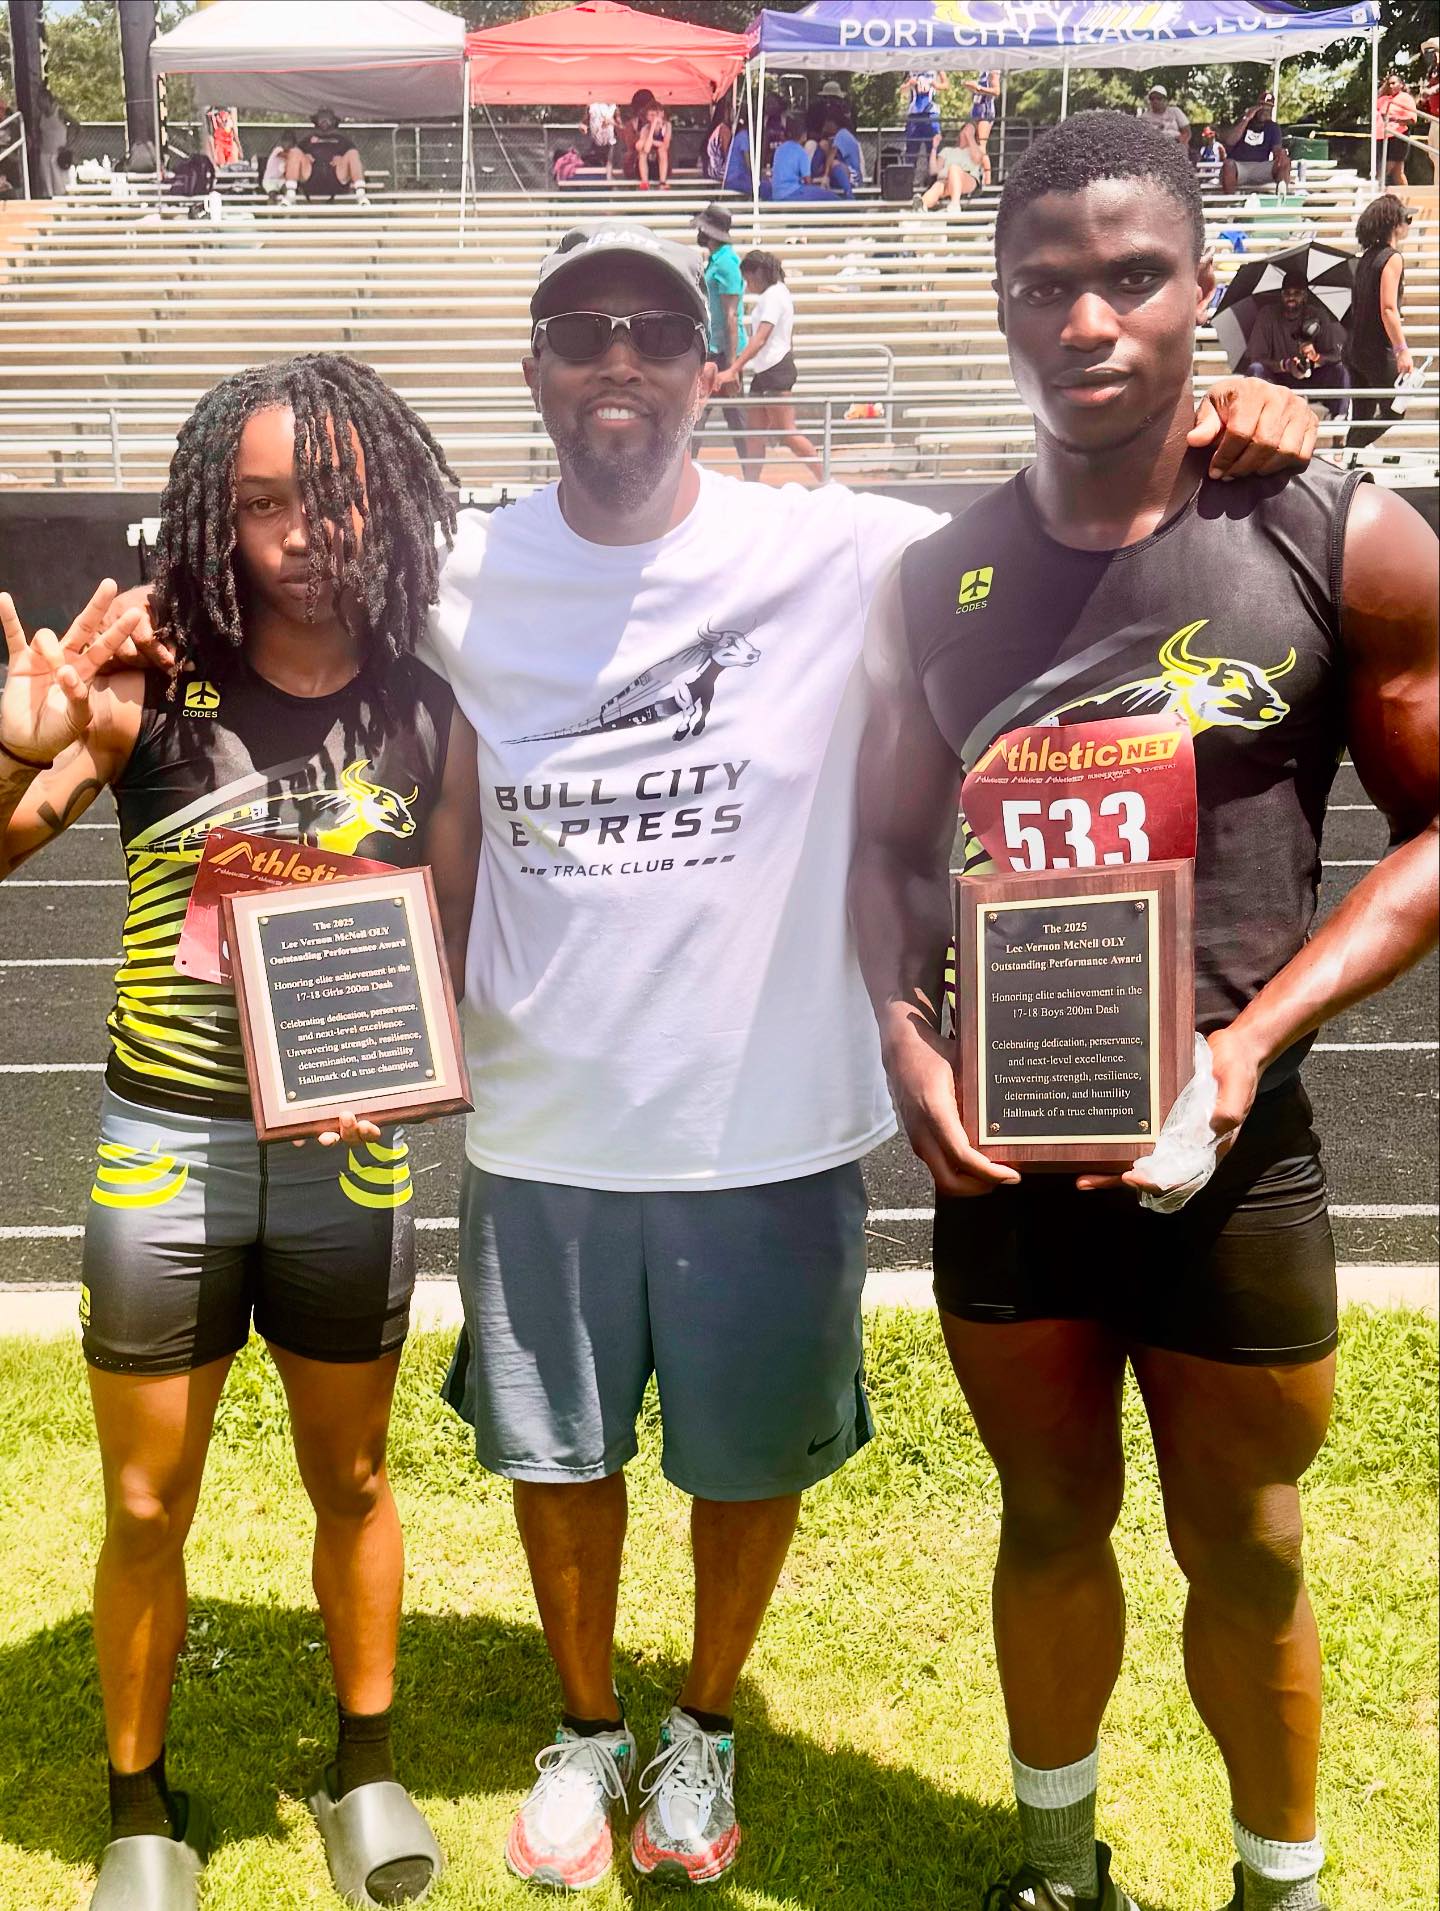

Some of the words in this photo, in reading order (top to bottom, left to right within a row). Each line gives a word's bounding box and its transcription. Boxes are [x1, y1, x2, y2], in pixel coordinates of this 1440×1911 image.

[839, 19, 937, 47] PORT
[956, 600, 987, 614] CODES
[182, 709, 218, 718] CODES
[495, 778, 617, 811] BULL
[635, 760, 751, 801] CITY
[1002, 791, 1150, 873] 533
[553, 863, 612, 877] TRACK
[620, 859, 674, 875] CLUB
[313, 922, 332, 931] The
[1043, 925, 1061, 934] The
[1065, 922, 1087, 932] 2025
[281, 942, 298, 950] Lee
[368, 927, 390, 936] OLY
[1006, 945, 1023, 954] Lee
[1026, 941, 1060, 952] Vernon
[1102, 937, 1126, 947] OLY
[270, 952, 322, 965] Outstanding
[324, 944, 377, 958] Performance
[379, 939, 406, 949] Award
[991, 960, 1046, 971] Outstanding
[1049, 957, 1107, 968] Performance
[1111, 954, 1142, 964] Award
[274, 978, 314, 990] Honoring
[316, 975, 333, 984] elite
[335, 968, 387, 982] achievement
[398, 963, 410, 972] the
[296, 991, 320, 1001] 17-18
[322, 986, 344, 998] Girls
[346, 984, 370, 994] 200m
[371, 980, 393, 990] Dash
[992, 992, 1033, 1002] Honoring
[1036, 991, 1054, 999] elite
[1057, 988, 1113, 999] achievement
[1116, 986, 1125, 995] in
[1128, 986, 1142, 994] the
[280, 1016, 325, 1029] Celebrating
[327, 1010, 369, 1023] dedication,
[1013, 1008, 1038, 1018] 17-18
[1041, 1008, 1063, 1019] Boys
[1067, 1005, 1093, 1015] 200m
[1096, 1004, 1119, 1014] Dash
[298, 1033, 314, 1041] and
[316, 1025, 357, 1038] next-level
[359, 1020, 406, 1033] excellence.
[286, 1044, 339, 1058] Unwavering
[340, 1037, 377, 1050] strength,
[379, 1031, 421, 1044] resilience,
[992, 1040, 1039, 1050] Celebrating
[1042, 1037, 1087, 1048] dedication,
[299, 1056, 360, 1070] determination,
[361, 1052, 377, 1060] and
[379, 1046, 414, 1058] humility
[1008, 1057, 1024, 1066] and
[1028, 1055, 1072, 1065] next-level
[1075, 1054, 1126, 1064] excellence.
[298, 1072, 339, 1085] Hallmark
[341, 1069, 350, 1078] of
[359, 1067, 376, 1076] true
[378, 1061, 419, 1073] champion
[995, 1074, 1049, 1085] Unwavering
[1052, 1072, 1091, 1083] strength,
[1095, 1071, 1141, 1081] resilience,
[1005, 1091, 1069, 1100] determination,
[1072, 1089, 1088, 1098] and
[1092, 1088, 1130, 1099] humility
[1004, 1108, 1044, 1117] Hallmark
[1048, 1107, 1059, 1116] of
[1067, 1108, 1085, 1116] true
[1088, 1106, 1133, 1117] champion
